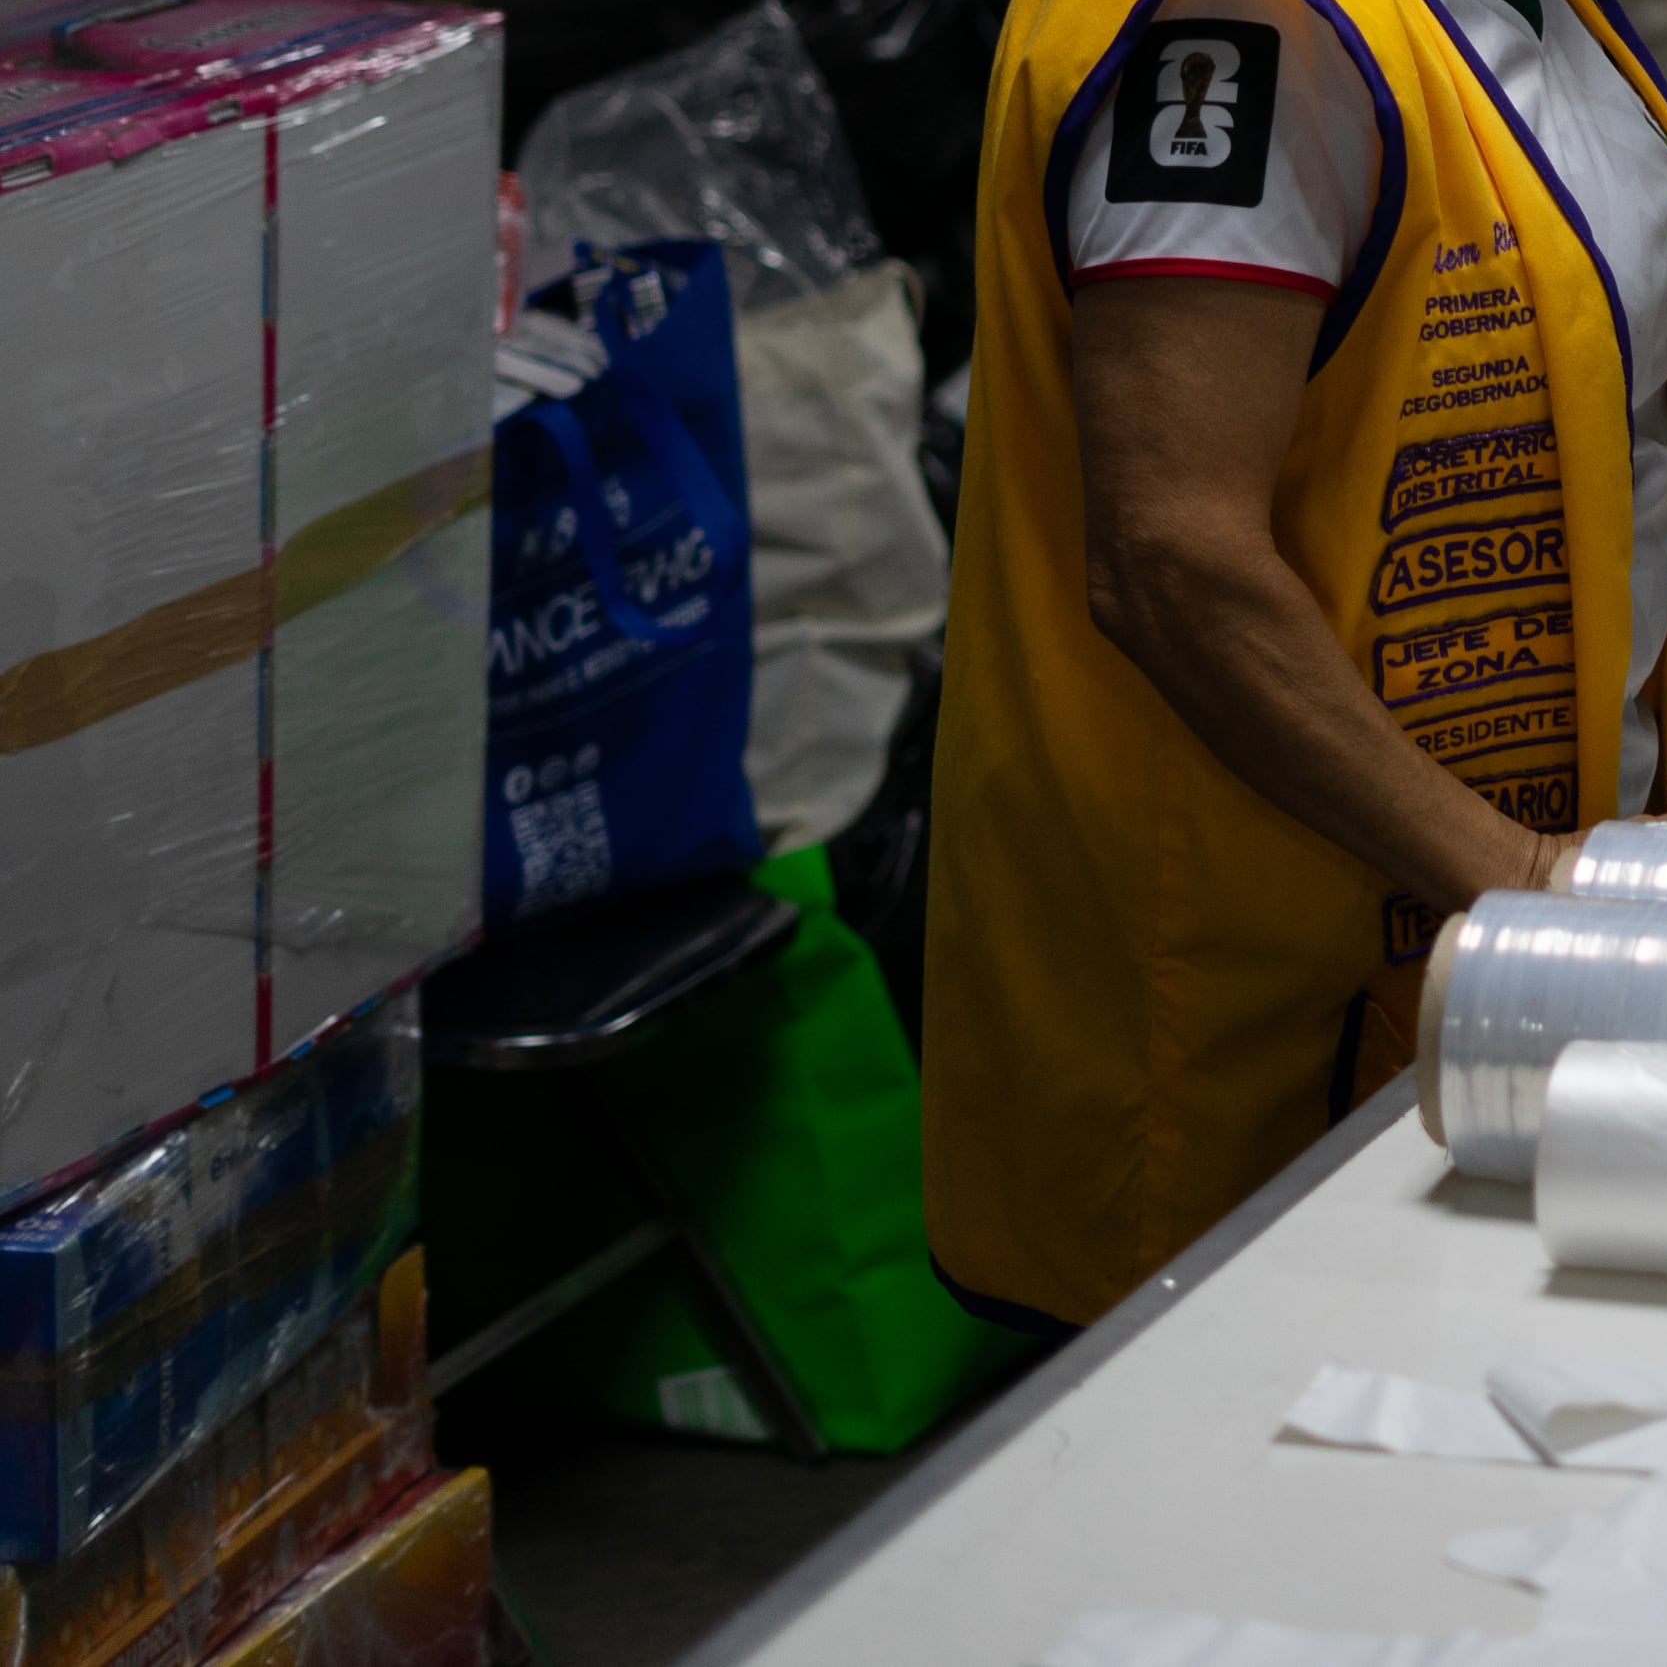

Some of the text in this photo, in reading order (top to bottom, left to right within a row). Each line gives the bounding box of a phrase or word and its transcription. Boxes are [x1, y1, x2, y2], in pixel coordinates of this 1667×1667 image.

[1170, 141, 1208, 156] FIFA
[1425, 286, 1521, 316] PRIMERA
[1419, 307, 1537, 342] GOBERNAD
[1432, 355, 1530, 388] SEGUNDA
[1397, 462, 1543, 510] DISTRITAL
[1387, 528, 1564, 598] ASESOR
[1387, 613, 1574, 668] JEFE DE
[1417, 646, 1541, 692] ZONA
[1415, 706, 1573, 754] RESIDENTE
